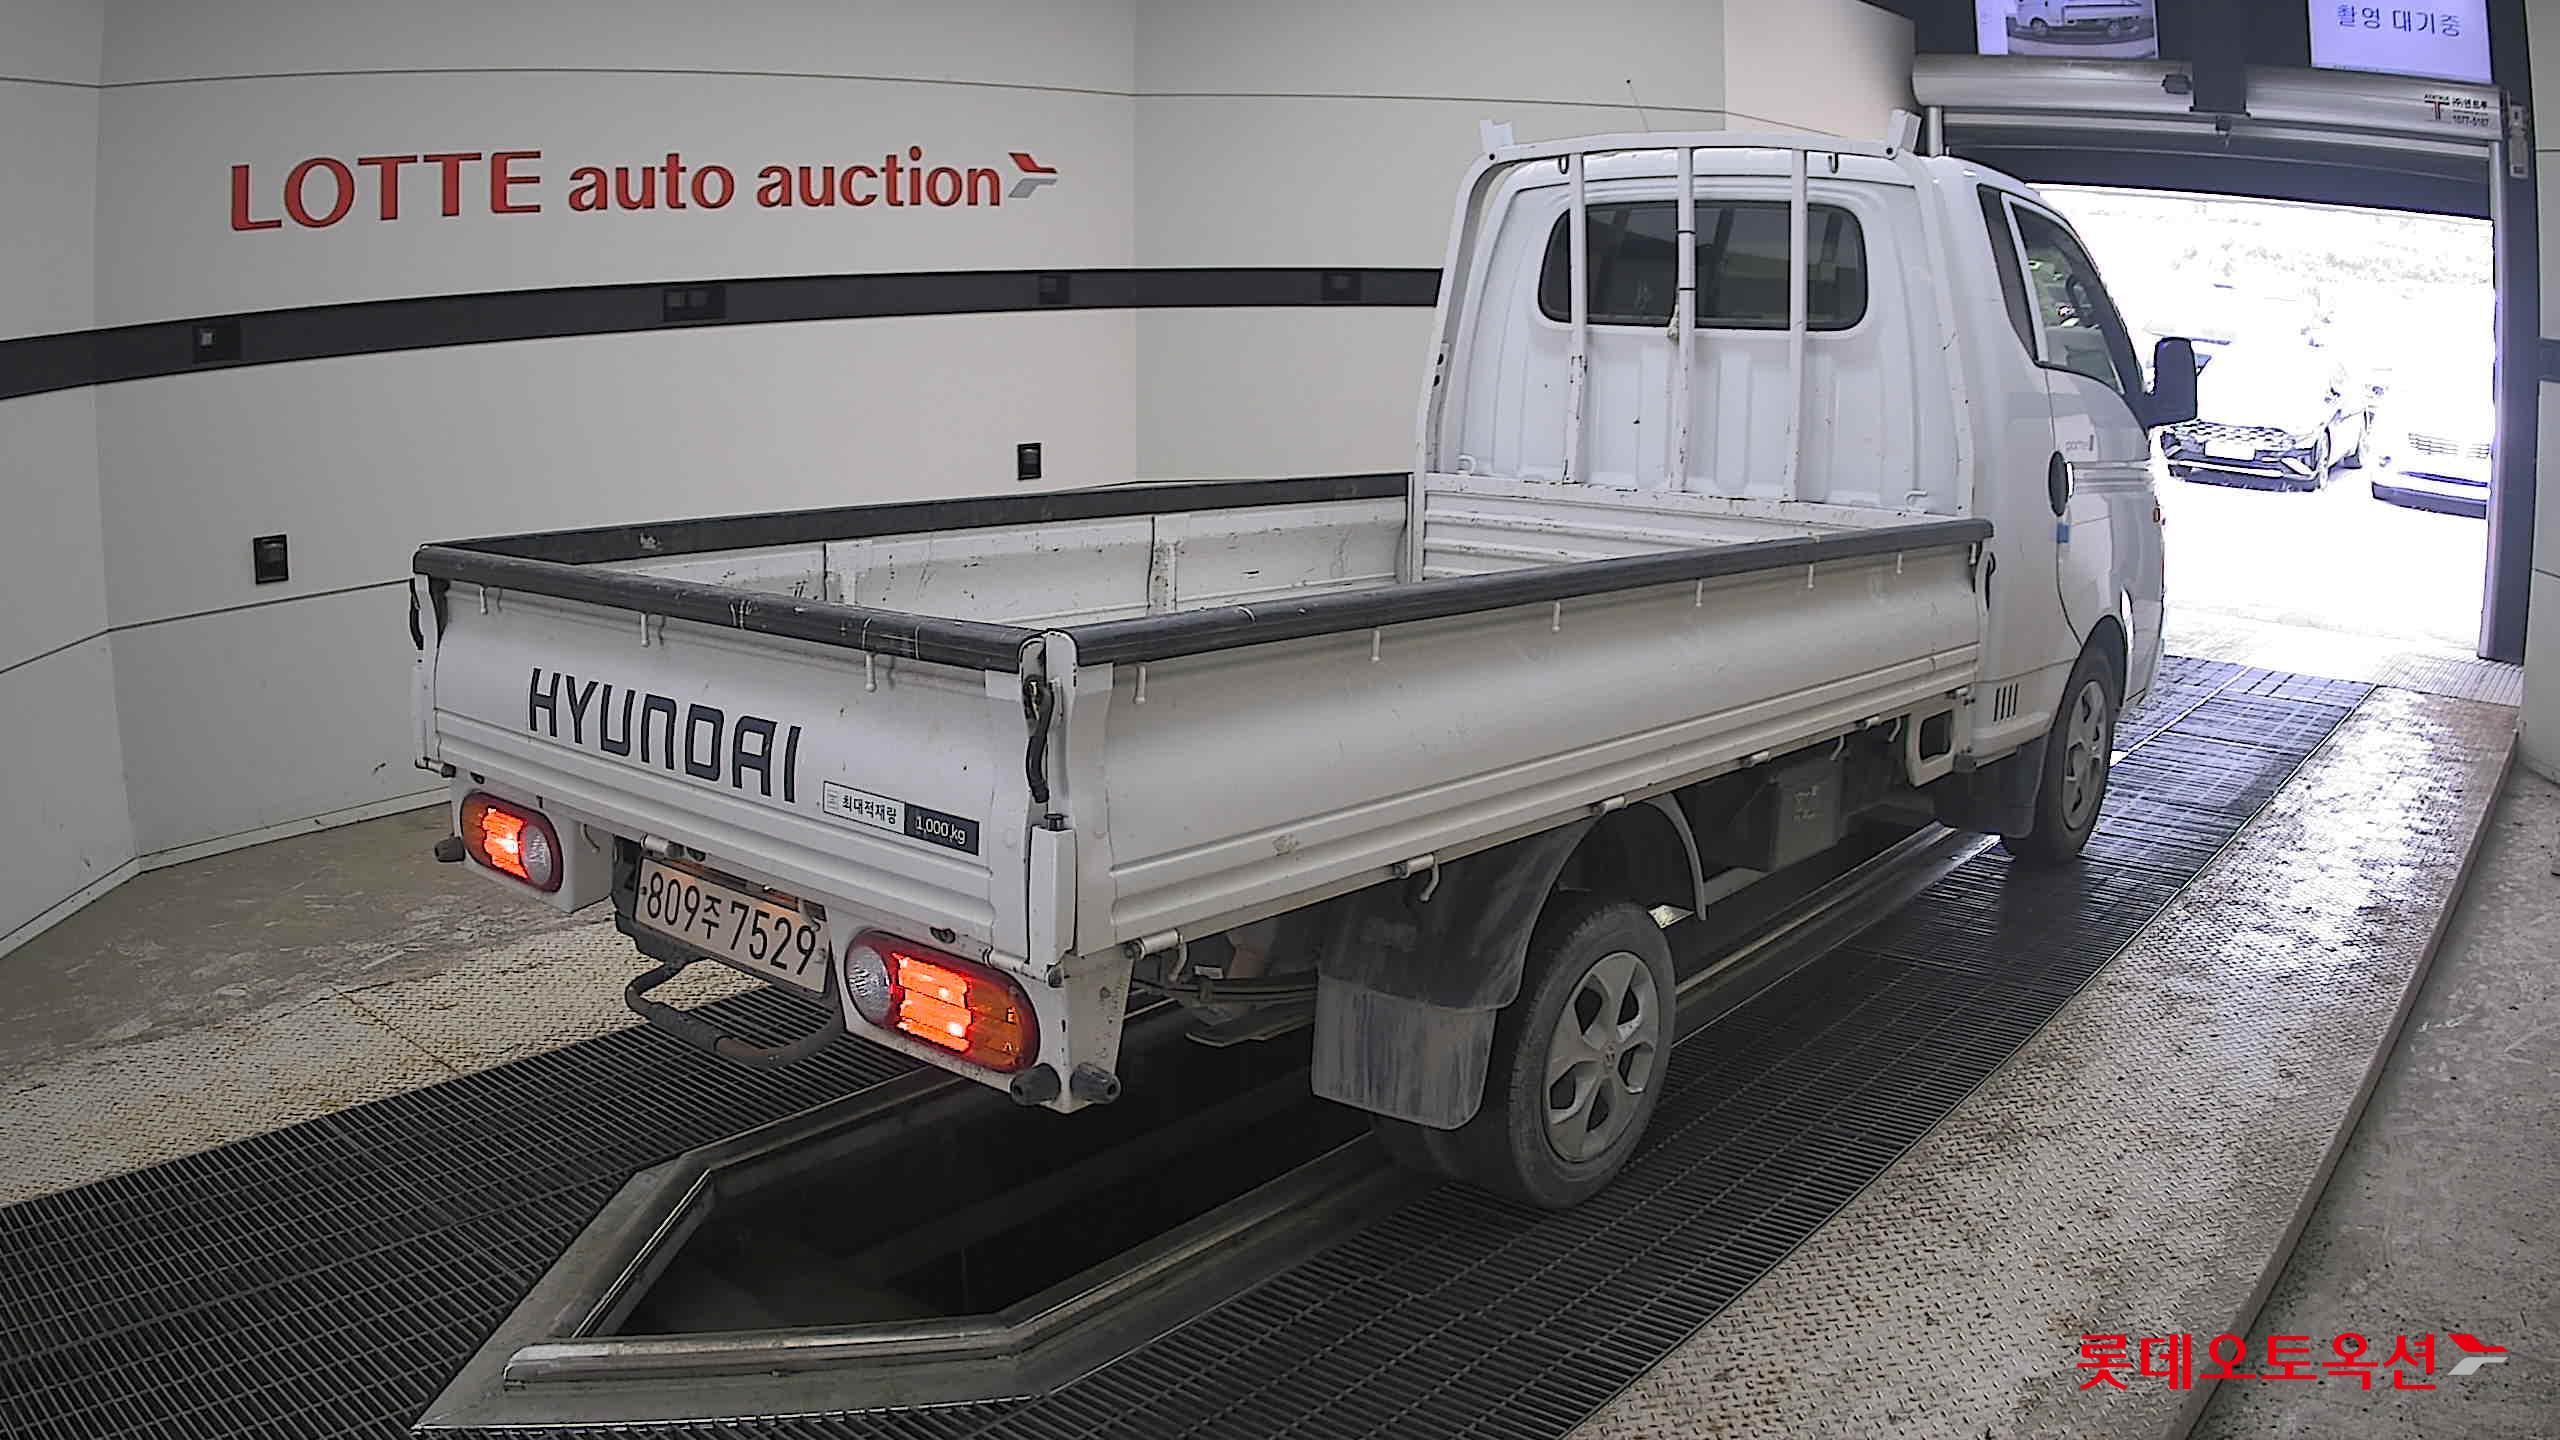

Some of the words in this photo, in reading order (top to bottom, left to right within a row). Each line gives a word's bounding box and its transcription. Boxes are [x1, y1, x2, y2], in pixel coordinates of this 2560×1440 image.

[2337, 4, 2381, 30] 촬영
[2392, 10, 2460, 37] 대기중
[231, 151, 540, 231] LOTTE
[568, 153, 736, 210] auto
[756, 147, 1002, 207] auction
[528, 667, 802, 803] HYUNDAI
[843, 795, 897, 825] 최대적재량
